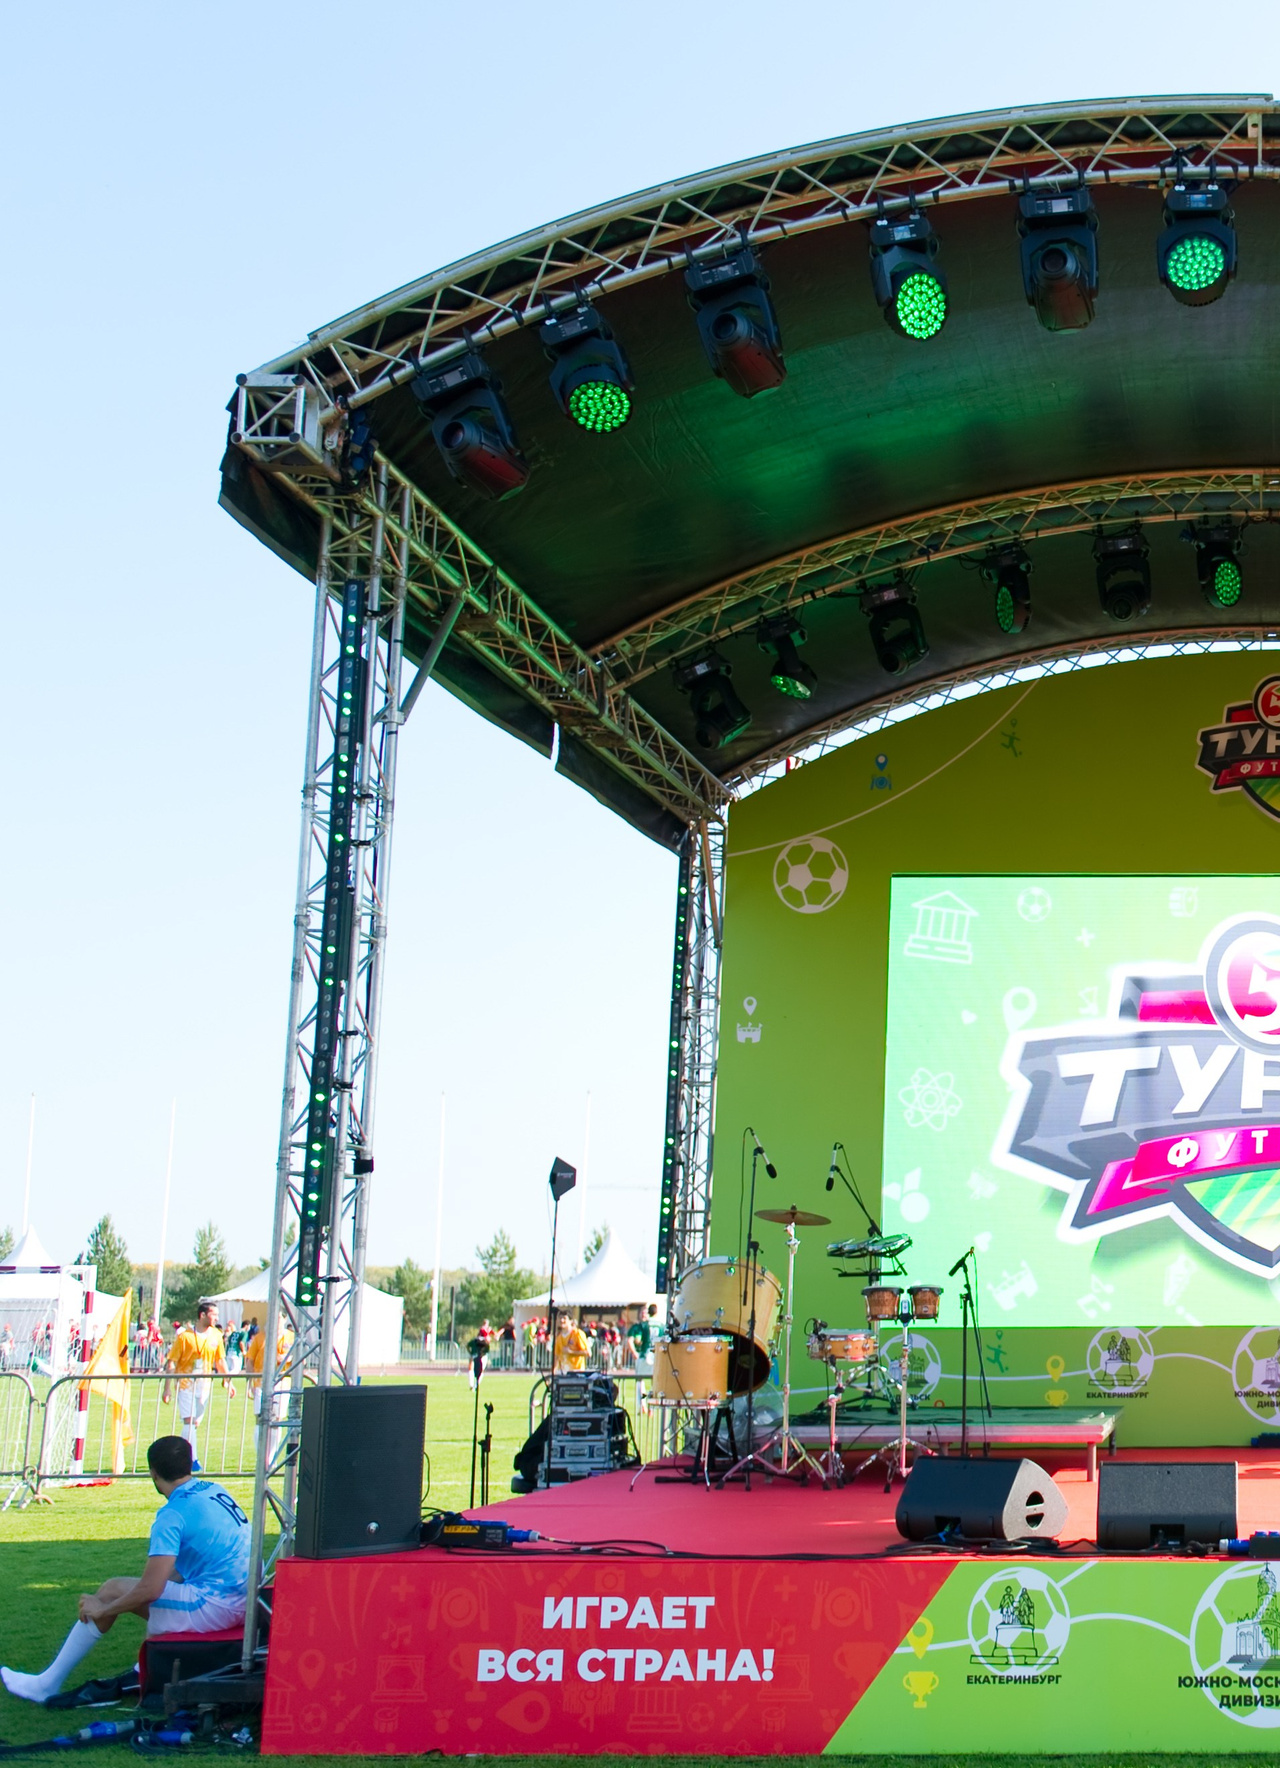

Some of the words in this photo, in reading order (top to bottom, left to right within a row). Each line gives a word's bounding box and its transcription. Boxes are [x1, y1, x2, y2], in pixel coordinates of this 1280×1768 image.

[1086, 1391, 1149, 1399] ЕКАТЕРИНБУРГ
[209, 1493, 248, 1527] 18
[543, 1596, 715, 1629] ИГРАЕТ
[477, 1648, 563, 1682] ВСЯ
[577, 1648, 775, 1682] СТРАНА!
[966, 1674, 1062, 1685] ЕКАТЕРИНБУРГ
